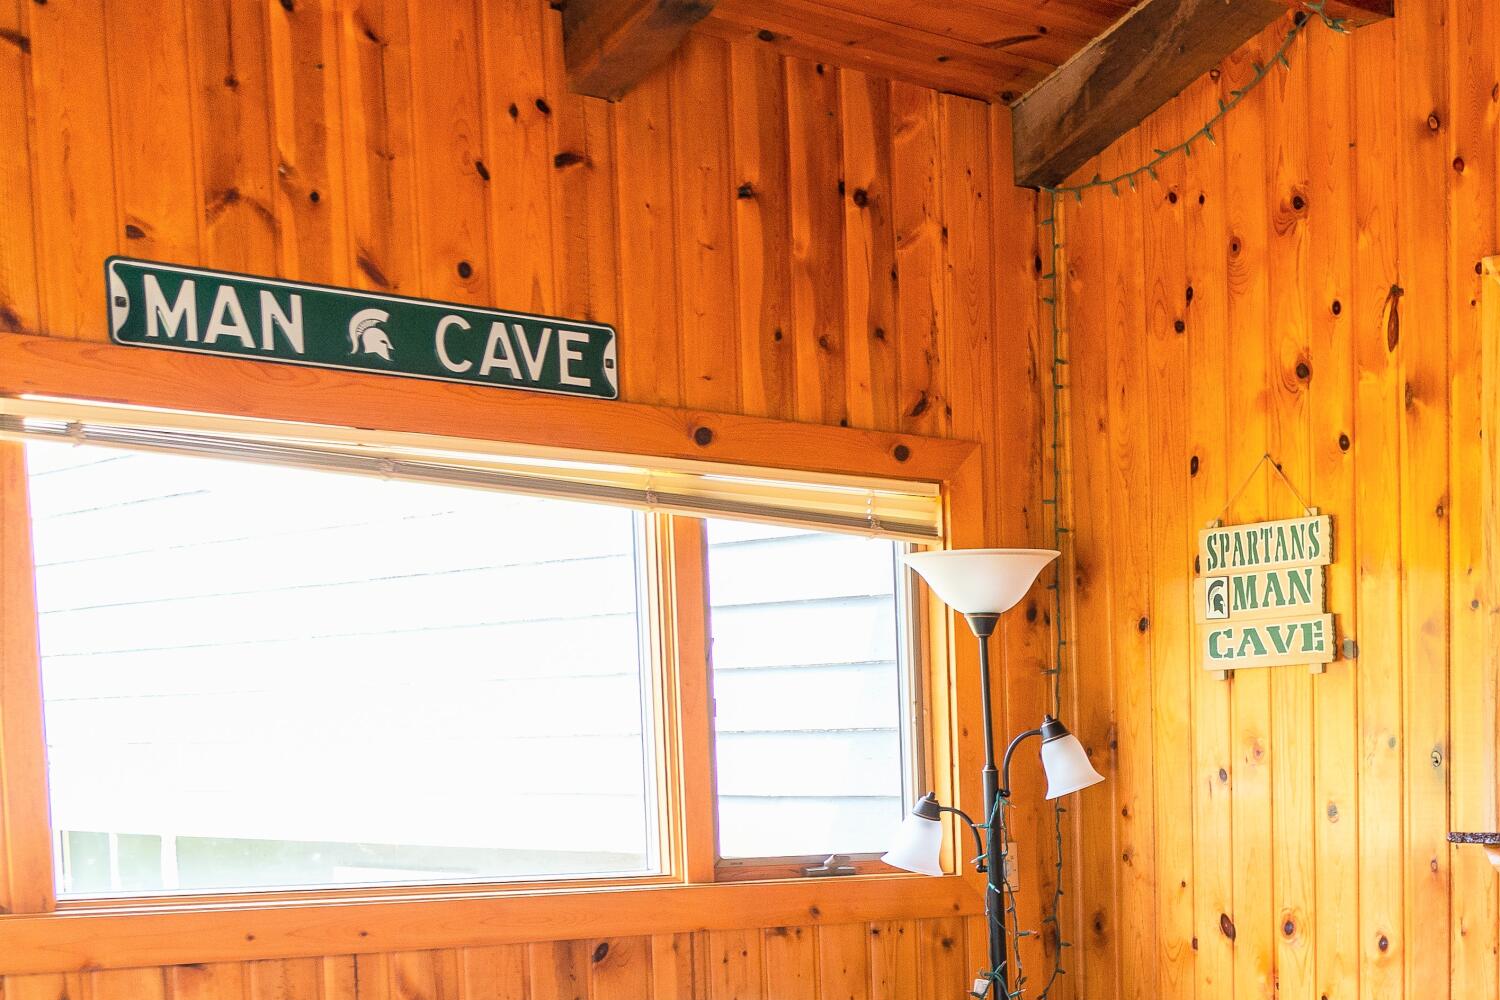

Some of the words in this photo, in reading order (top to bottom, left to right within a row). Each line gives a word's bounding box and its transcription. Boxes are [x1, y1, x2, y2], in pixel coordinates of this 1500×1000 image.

[142, 274, 305, 354] MAN
[434, 314, 592, 388] CAVE
[1206, 519, 1321, 572] SPARTANS
[1232, 568, 1314, 611] MAN
[1208, 620, 1325, 660] CAVE
